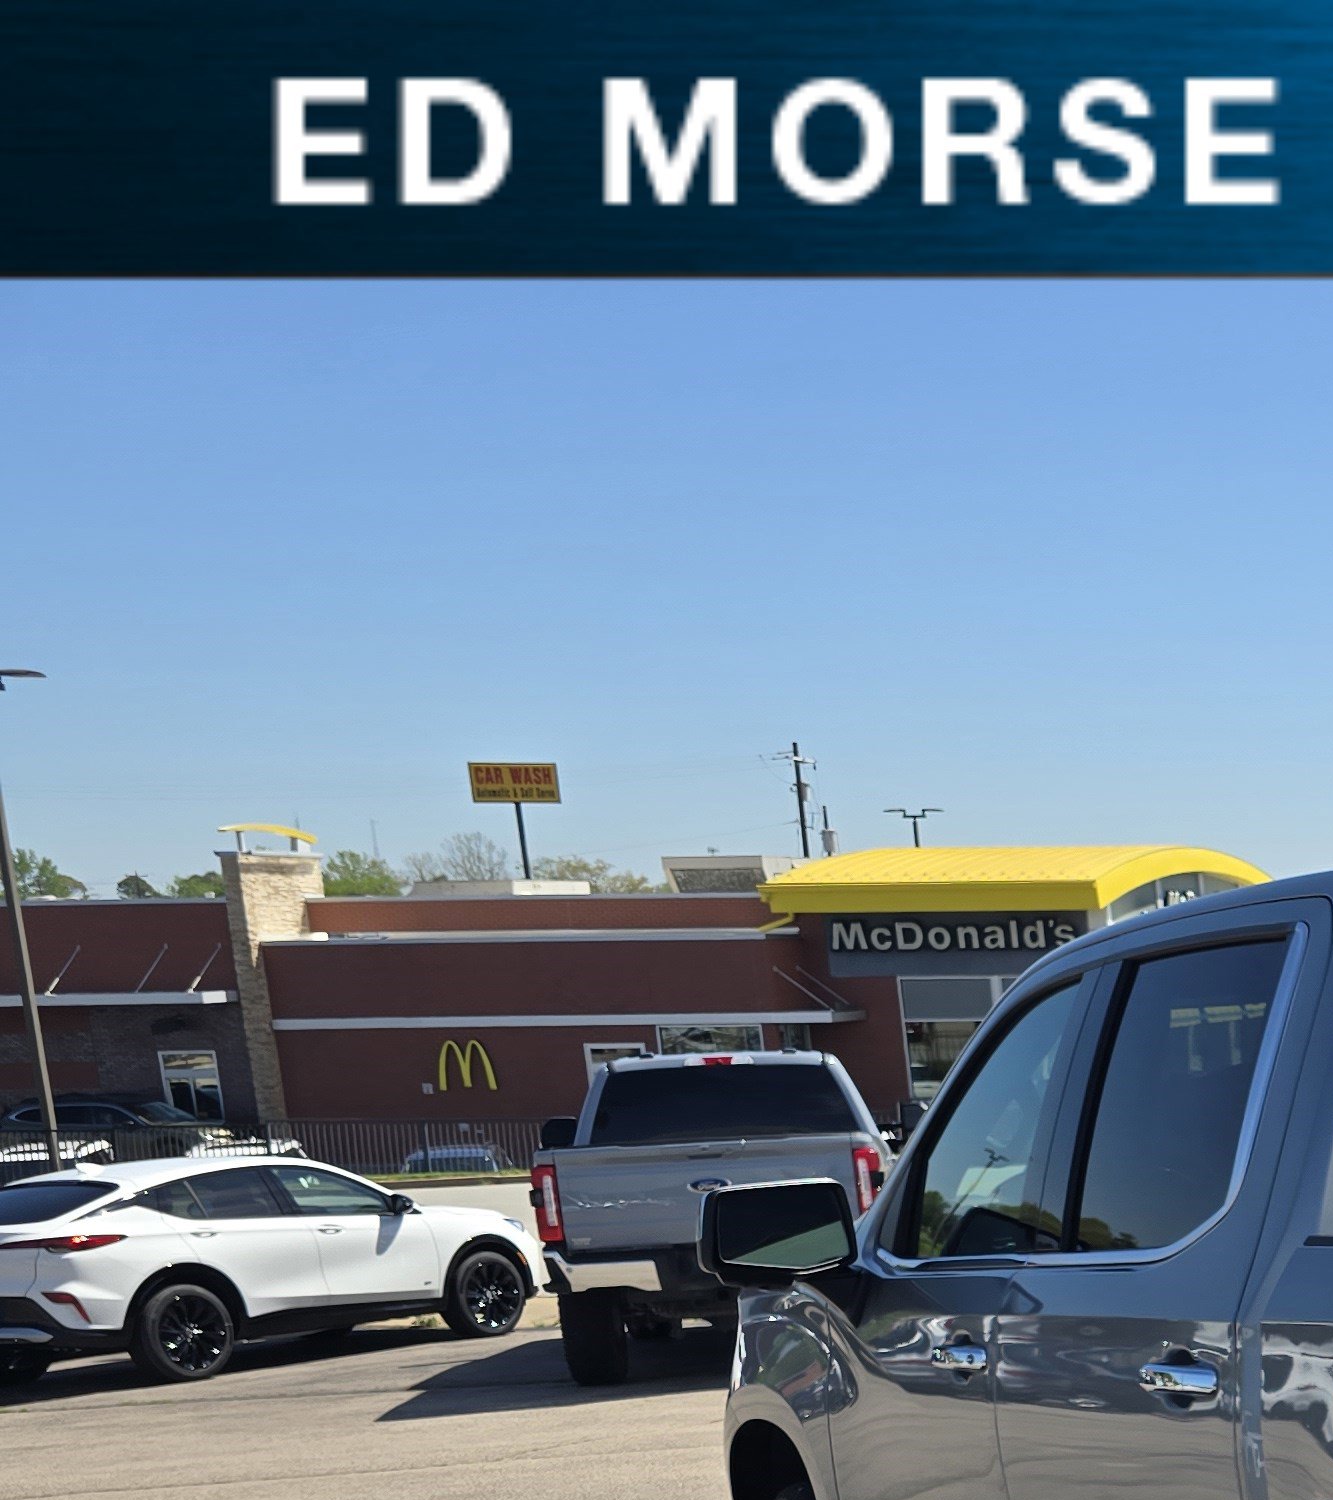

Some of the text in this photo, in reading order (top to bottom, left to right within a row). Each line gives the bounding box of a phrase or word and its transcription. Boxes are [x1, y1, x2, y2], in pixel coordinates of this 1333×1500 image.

[474, 766, 553, 785] CAR WASH
[831, 919, 1077, 952] McDonald's
